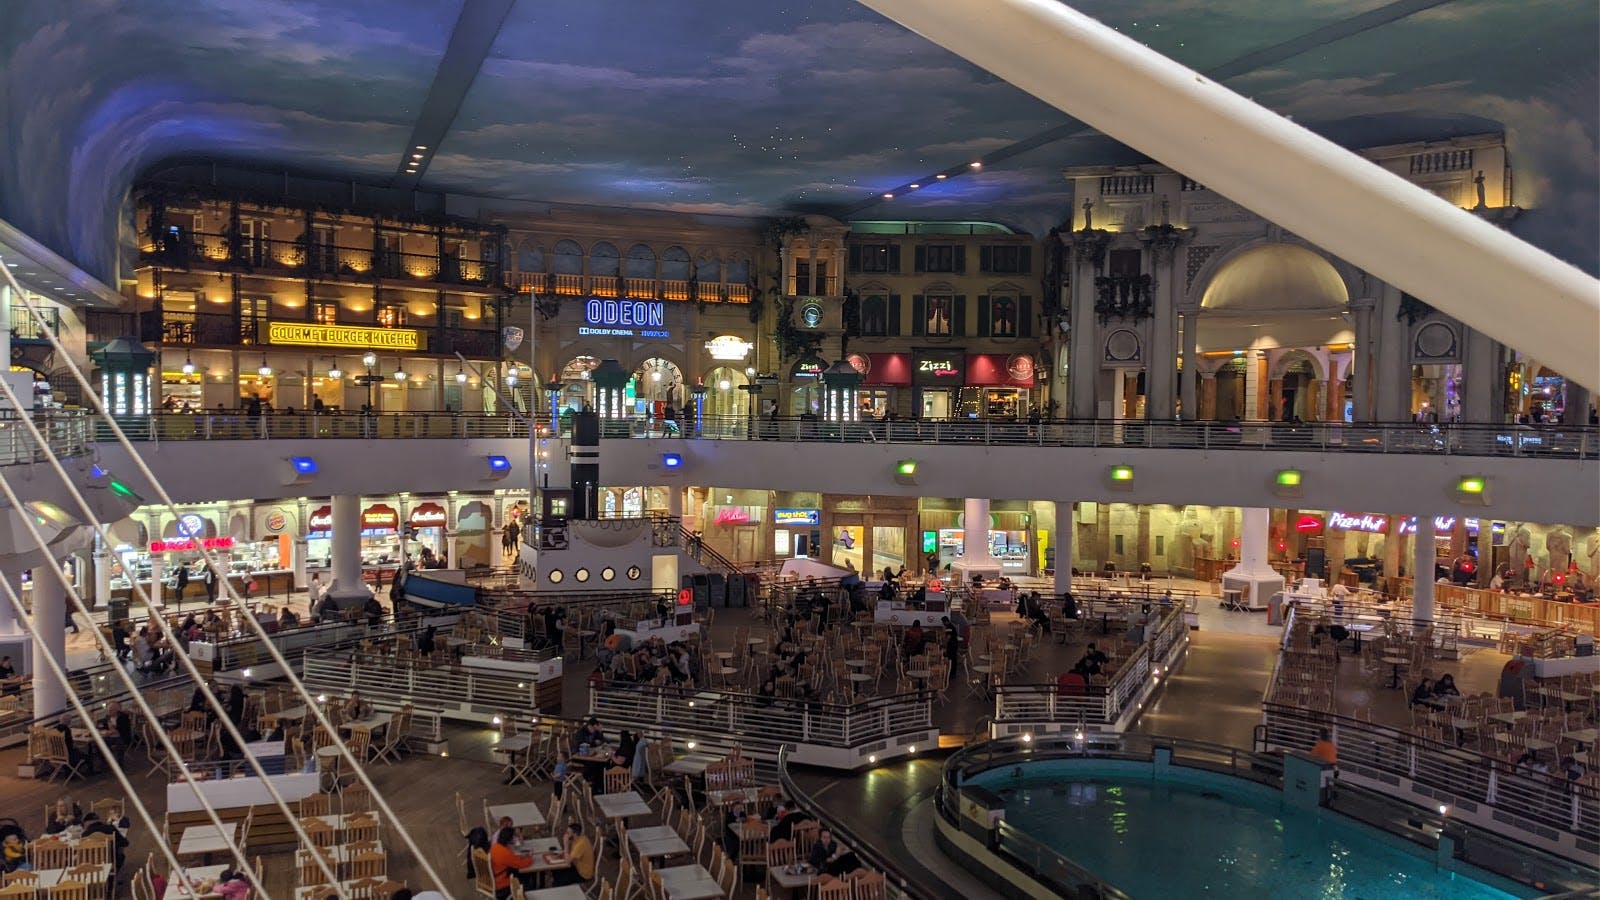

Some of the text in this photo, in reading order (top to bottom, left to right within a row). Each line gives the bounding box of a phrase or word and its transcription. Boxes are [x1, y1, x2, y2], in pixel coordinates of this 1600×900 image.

[587, 299, 664, 327] ODEON
[270, 326, 417, 346] GOURMET BURGER KITCHEN
[590, 328, 611, 336] DOLBY
[919, 360, 951, 371] Zizzi
[1329, 512, 1361, 528] Pizza
[1361, 515, 1386, 531] Hut
[1434, 515, 1455, 530] Hut
[203, 536, 234, 549] KING
